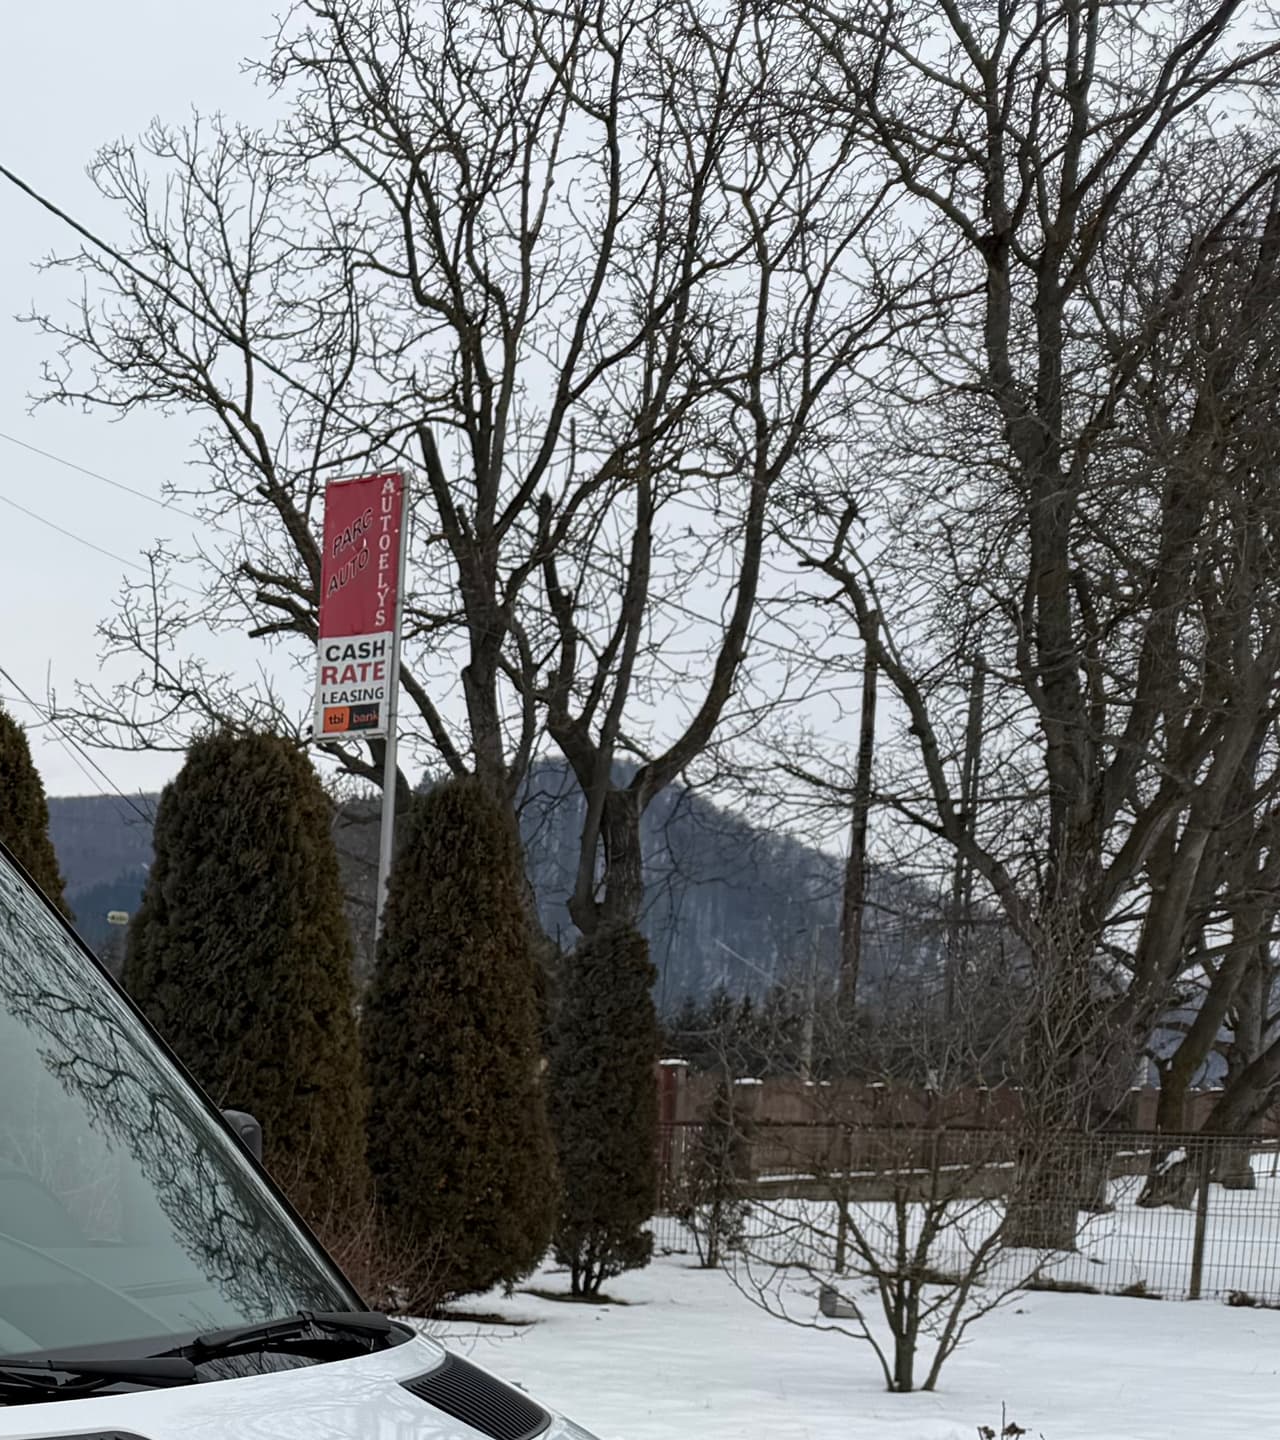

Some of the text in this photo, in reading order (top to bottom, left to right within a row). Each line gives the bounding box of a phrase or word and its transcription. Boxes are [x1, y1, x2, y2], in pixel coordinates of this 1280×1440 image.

[332, 507, 373, 559] PARC
[374, 478, 395, 627] AUTOELYS
[326, 548, 370, 599] AUTO
[325, 639, 386, 662] CASH
[321, 660, 386, 686] RATE
[322, 686, 385, 705] LEASING
[328, 712, 345, 725] tbi
